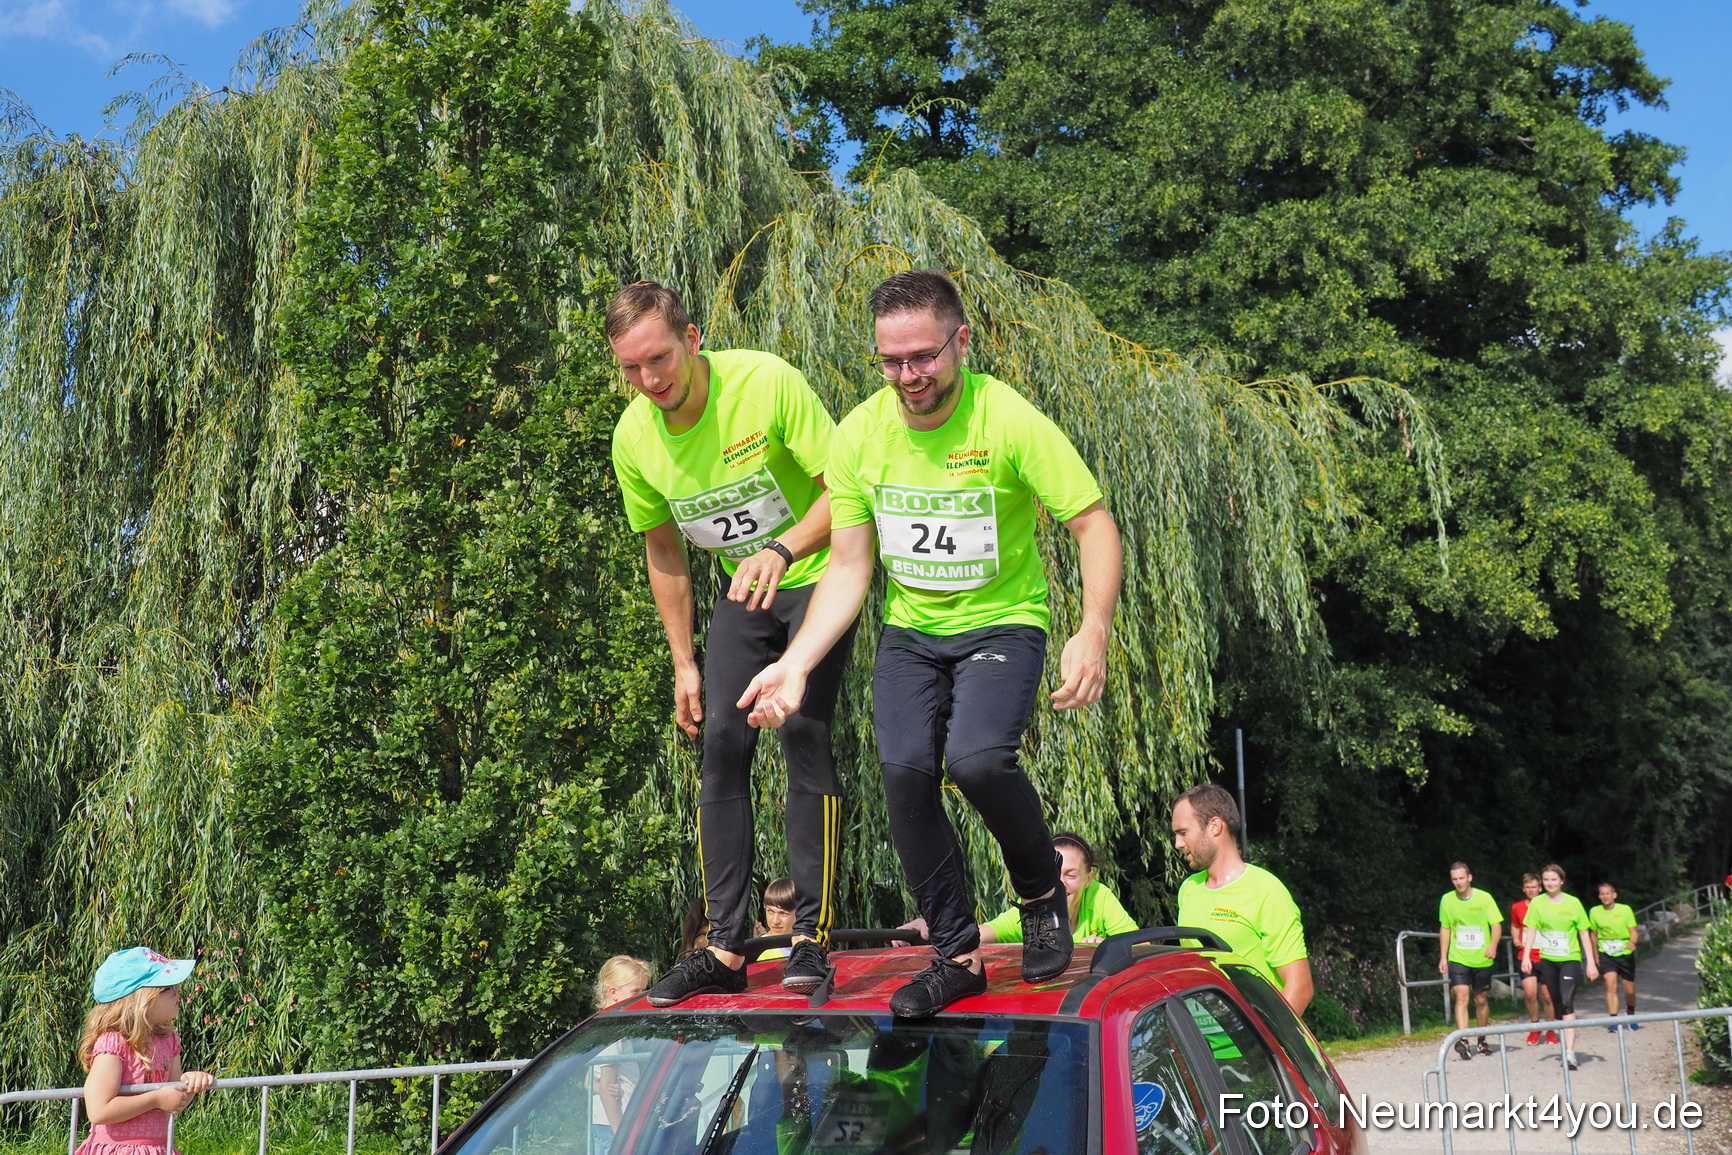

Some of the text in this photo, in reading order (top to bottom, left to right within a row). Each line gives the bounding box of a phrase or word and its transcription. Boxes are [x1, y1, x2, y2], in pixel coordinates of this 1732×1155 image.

[676, 475, 769, 519] BOCK
[883, 489, 984, 515] BOCK
[712, 509, 758, 542] 25
[910, 523, 957, 555] 24
[892, 560, 984, 578] BENJAMIN
[1548, 939, 1559, 948] 19
